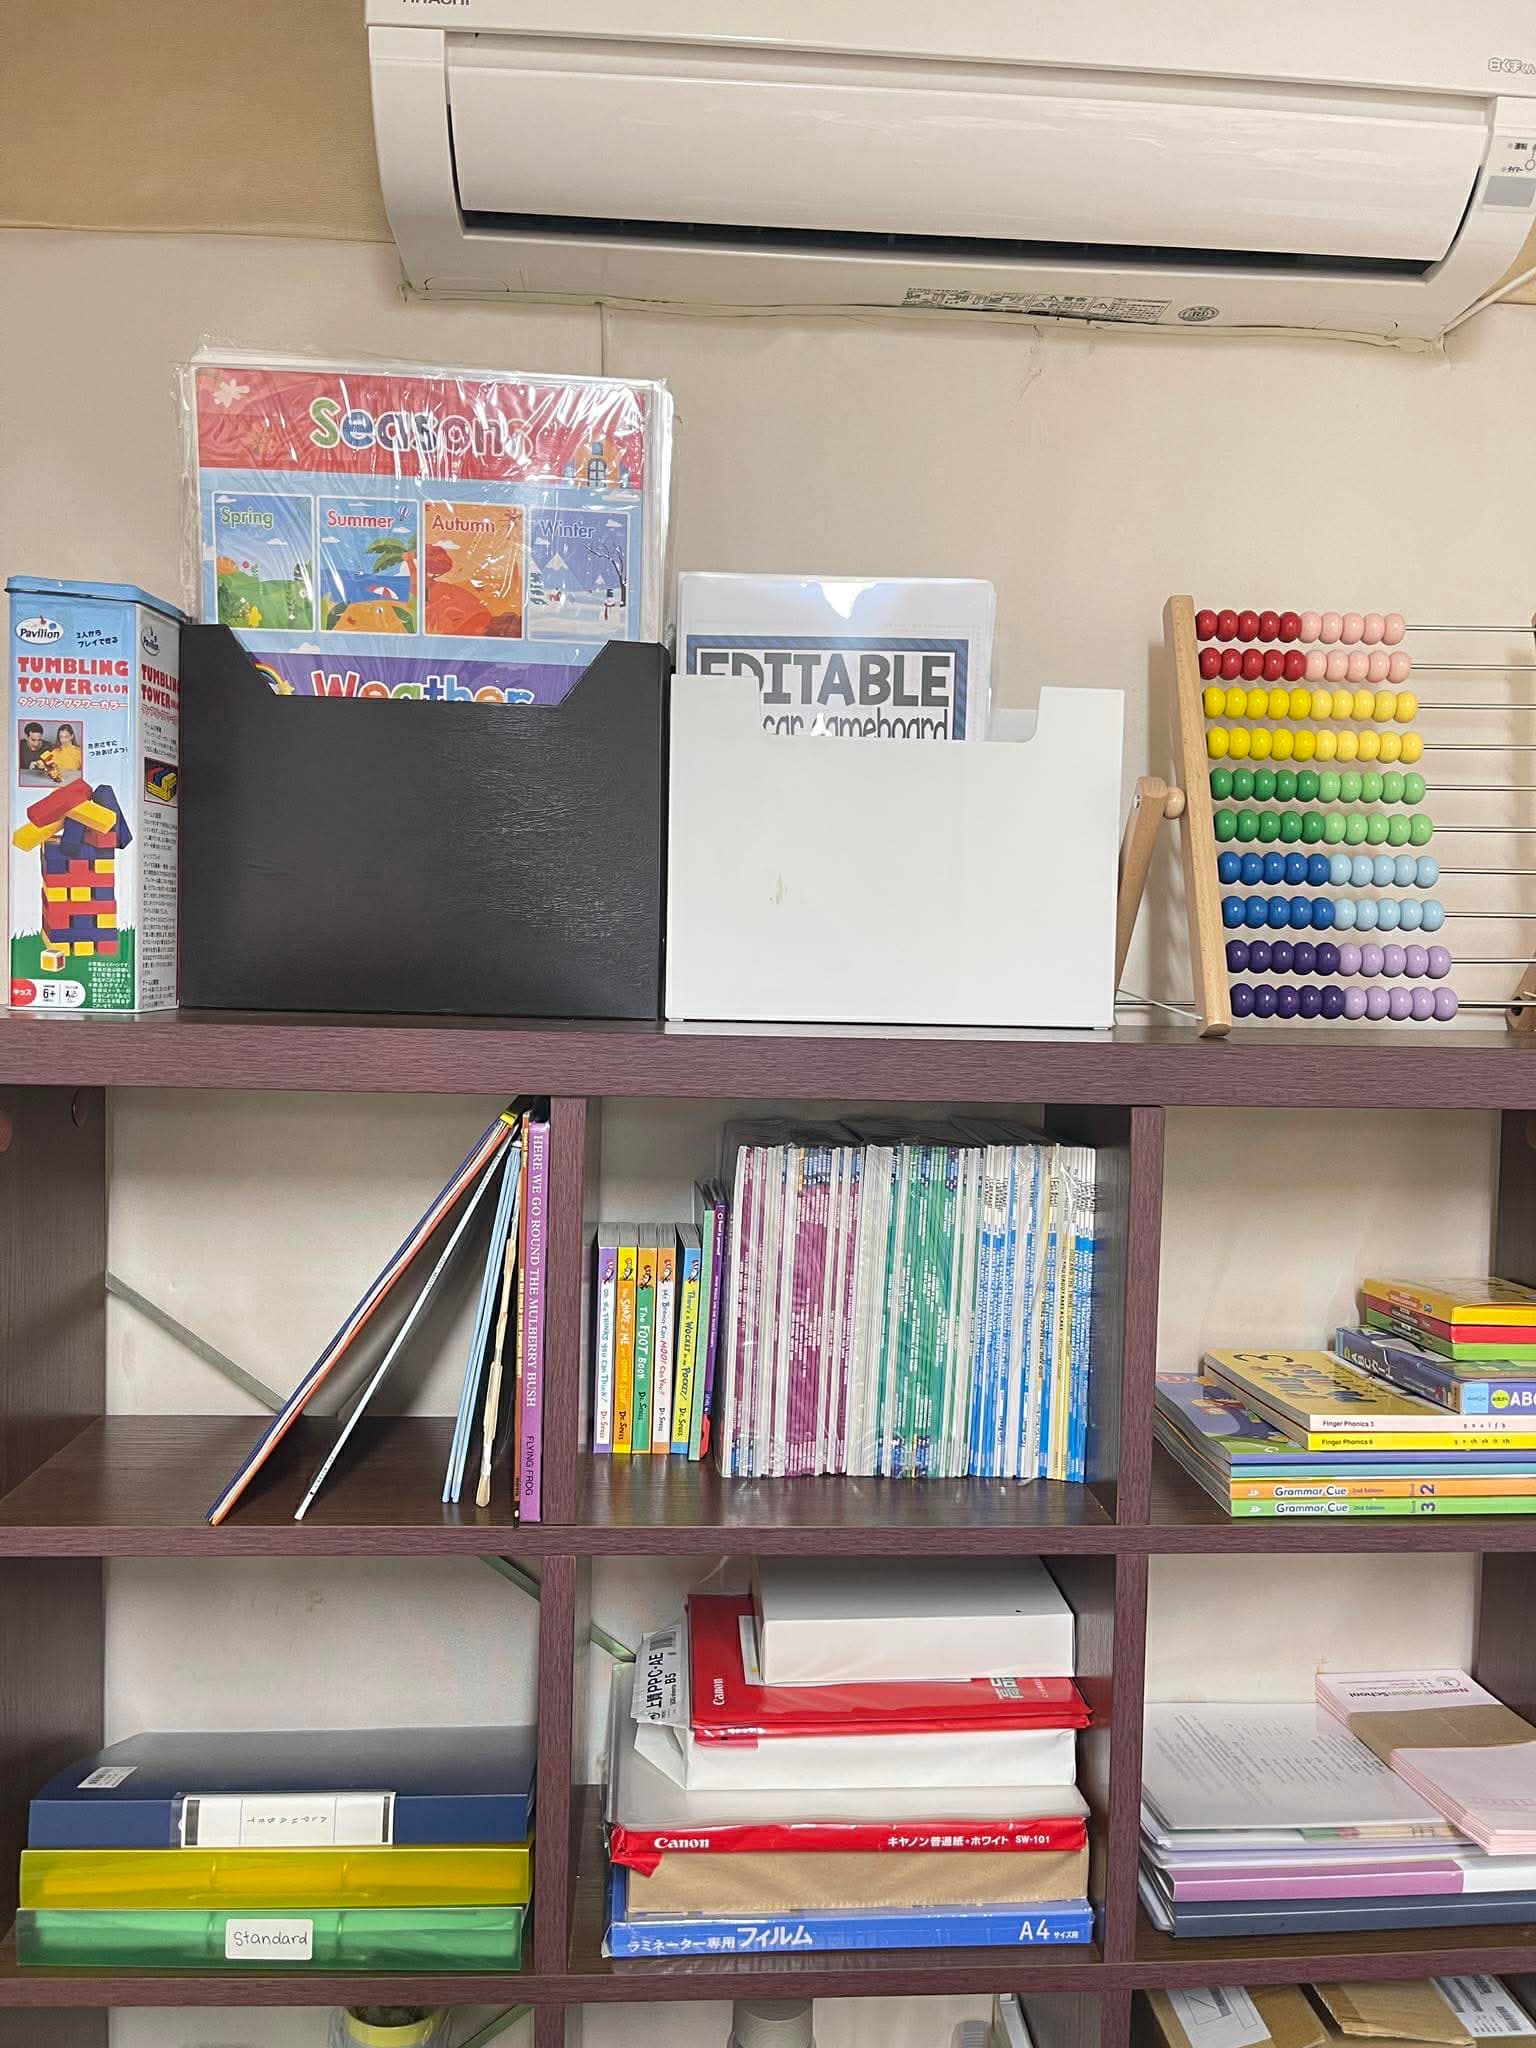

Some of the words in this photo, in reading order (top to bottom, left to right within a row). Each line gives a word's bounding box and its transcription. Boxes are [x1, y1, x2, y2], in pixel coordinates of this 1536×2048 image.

[221, 508, 274, 528] Spring
[328, 510, 394, 530] Summer
[431, 514, 496, 533] Autumn
[539, 518, 595, 540] Winter
[20, 628, 60, 640] Pavilion
[17, 656, 129, 677] TUMBLING
[17, 677, 92, 696] TOWER
[94, 683, 129, 695] COLOR
[141, 684, 171, 710] TOWER
[43, 989, 56, 999] 6+
[532, 1135, 543, 1170] HERE
[532, 1174, 543, 1194] WE
[531, 1197, 542, 1216] GO
[530, 1220, 541, 1265] ROUND
[529, 1269, 540, 1291] THE
[639, 1306, 648, 1323] The
[527, 1297, 539, 1369] MULBERRY
[637, 1325, 650, 1354] FOOT
[660, 1325, 668, 1338] Can
[684, 1321, 694, 1352] WOCKET
[526, 1372, 538, 1407] BUSH
[1510, 1391, 1536, 1407] AB
[1322, 1420, 1343, 1428] Finger
[1343, 1420, 1367, 1428] Phonics
[525, 1435, 535, 1468] FLYING
[1343, 1438, 1368, 1446] Phonics
[525, 1469, 534, 1496] FROG
[1275, 1486, 1323, 1497] Grammar
[1326, 1486, 1347, 1495] Cue
[1420, 1484, 1435, 1495] 2
[1276, 1503, 1324, 1513] Grammar
[1327, 1502, 1348, 1512] Cue
[1421, 1502, 1436, 1512] 3
[664, 1672, 677, 1684] B5
[713, 1678, 725, 1705] Canon
[654, 1837, 710, 1849] Canon
[1015, 1835, 1050, 1844] SW-101
[233, 1931, 307, 1947] Standard
[628, 1936, 736, 1952] ラミネーター専用
[737, 1925, 813, 1948] フィルム
[1019, 1919, 1050, 1941] A4
